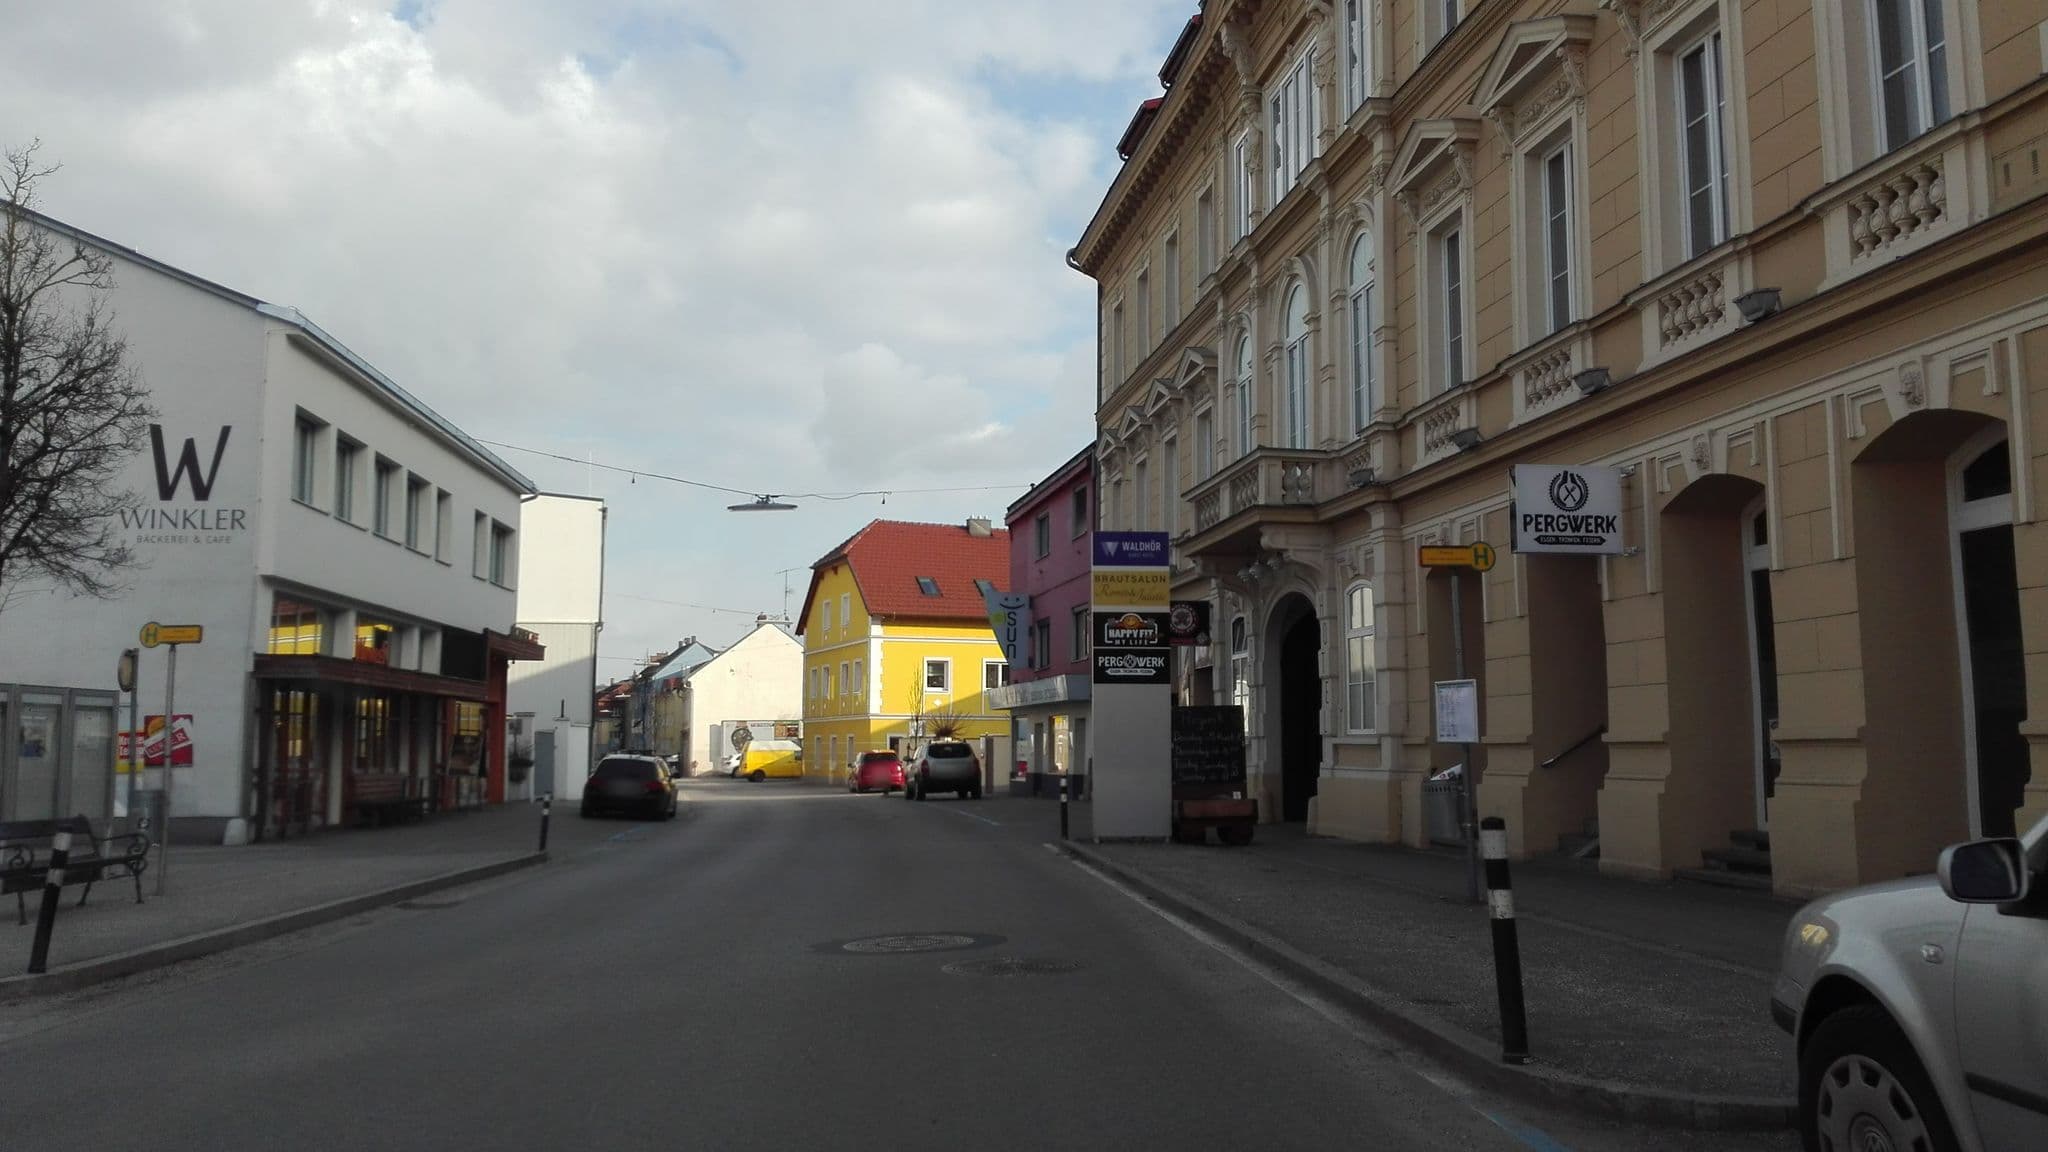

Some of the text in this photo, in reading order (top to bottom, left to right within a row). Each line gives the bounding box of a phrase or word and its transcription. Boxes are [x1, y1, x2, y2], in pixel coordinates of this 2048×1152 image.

[150, 424, 232, 501] W
[120, 508, 247, 530] WINKLER
[1522, 513, 1617, 534] PERGWERK
[193, 535, 201, 544] &
[1121, 539, 1161, 551] WALDHÖR
[1474, 547, 1489, 566] H
[1108, 629, 1154, 638] HAPPY FIT
